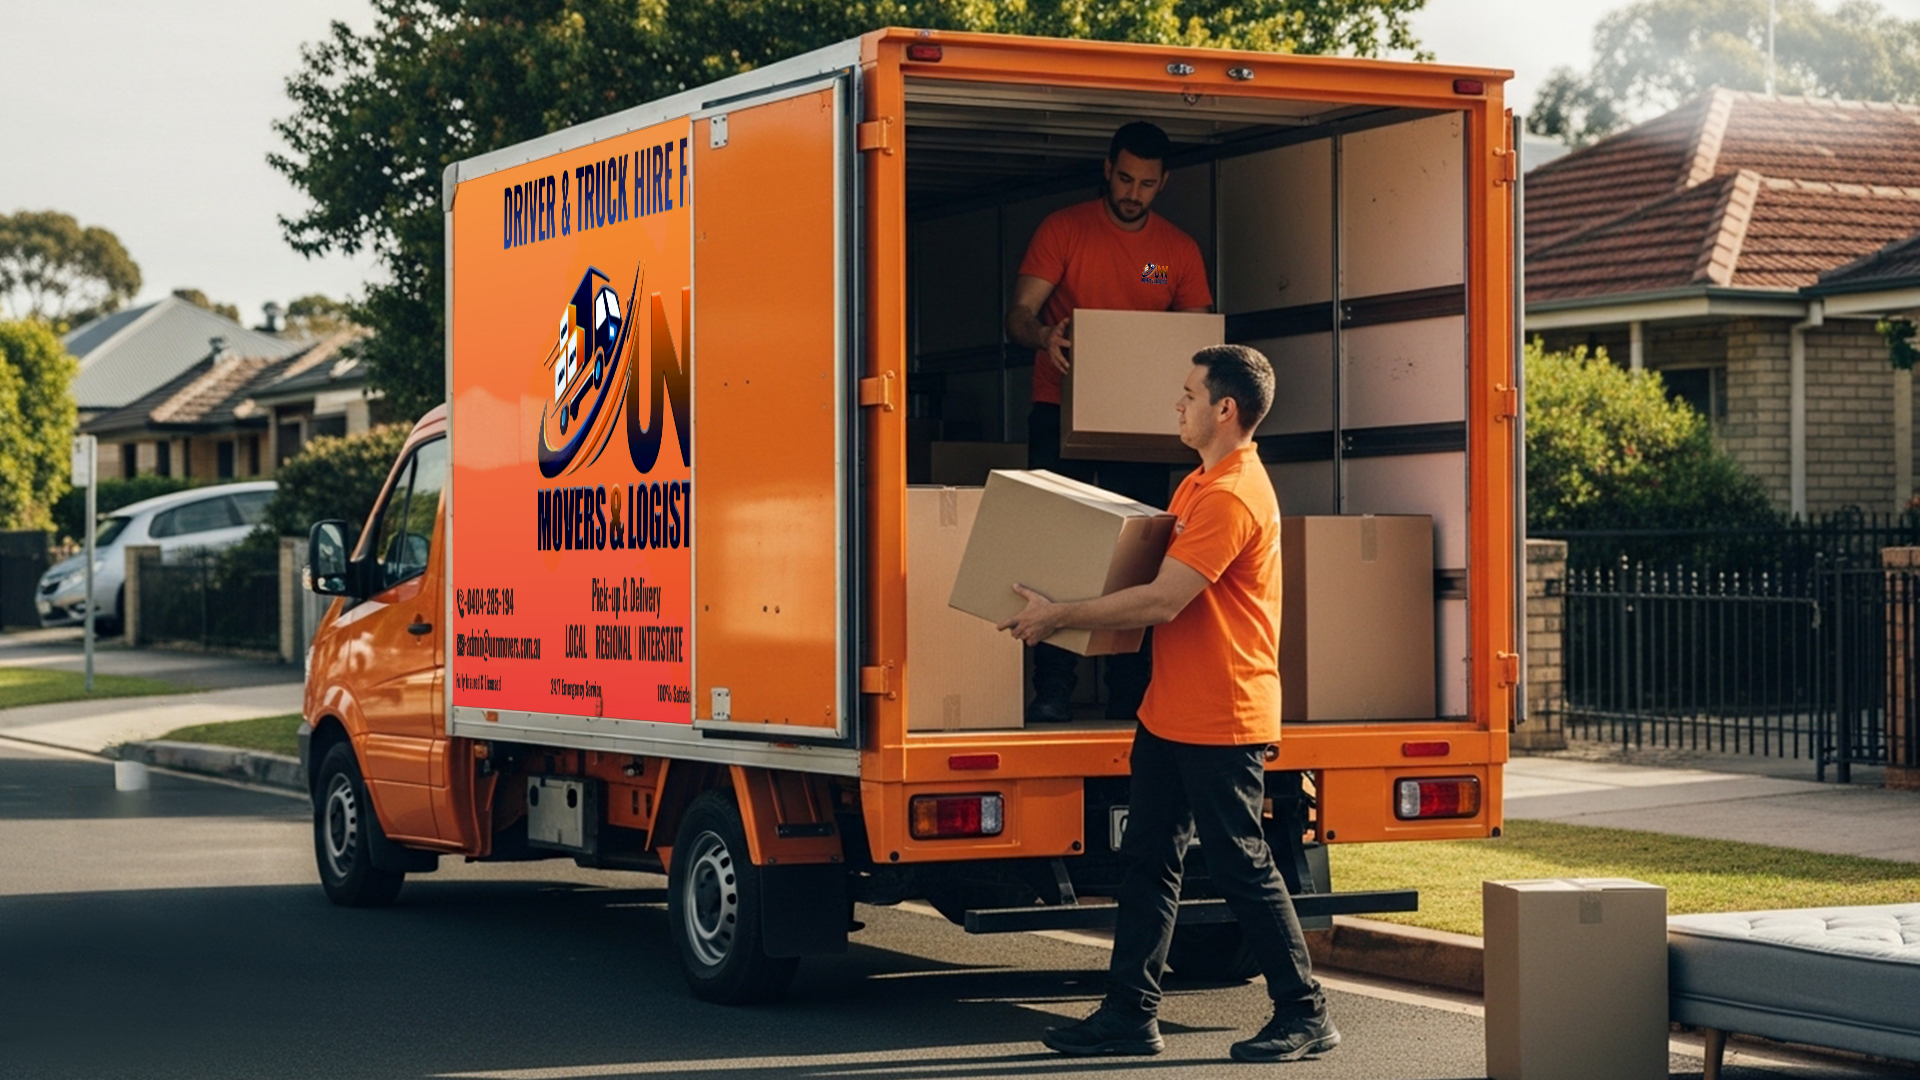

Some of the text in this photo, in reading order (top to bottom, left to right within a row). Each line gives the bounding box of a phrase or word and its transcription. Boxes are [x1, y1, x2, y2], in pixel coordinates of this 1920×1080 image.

[504, 137, 691, 250] DRIVER & TRUCK HIRE F
[537, 479, 691, 552] MOVERS & LOGIST
[592, 577, 661, 620] Pick-up & Delivery
[565, 624, 683, 663] LOCAL REGIONAL INTERSTATE
[561, 679, 585, 700] Emergency
[657, 684, 672, 703] 100%
